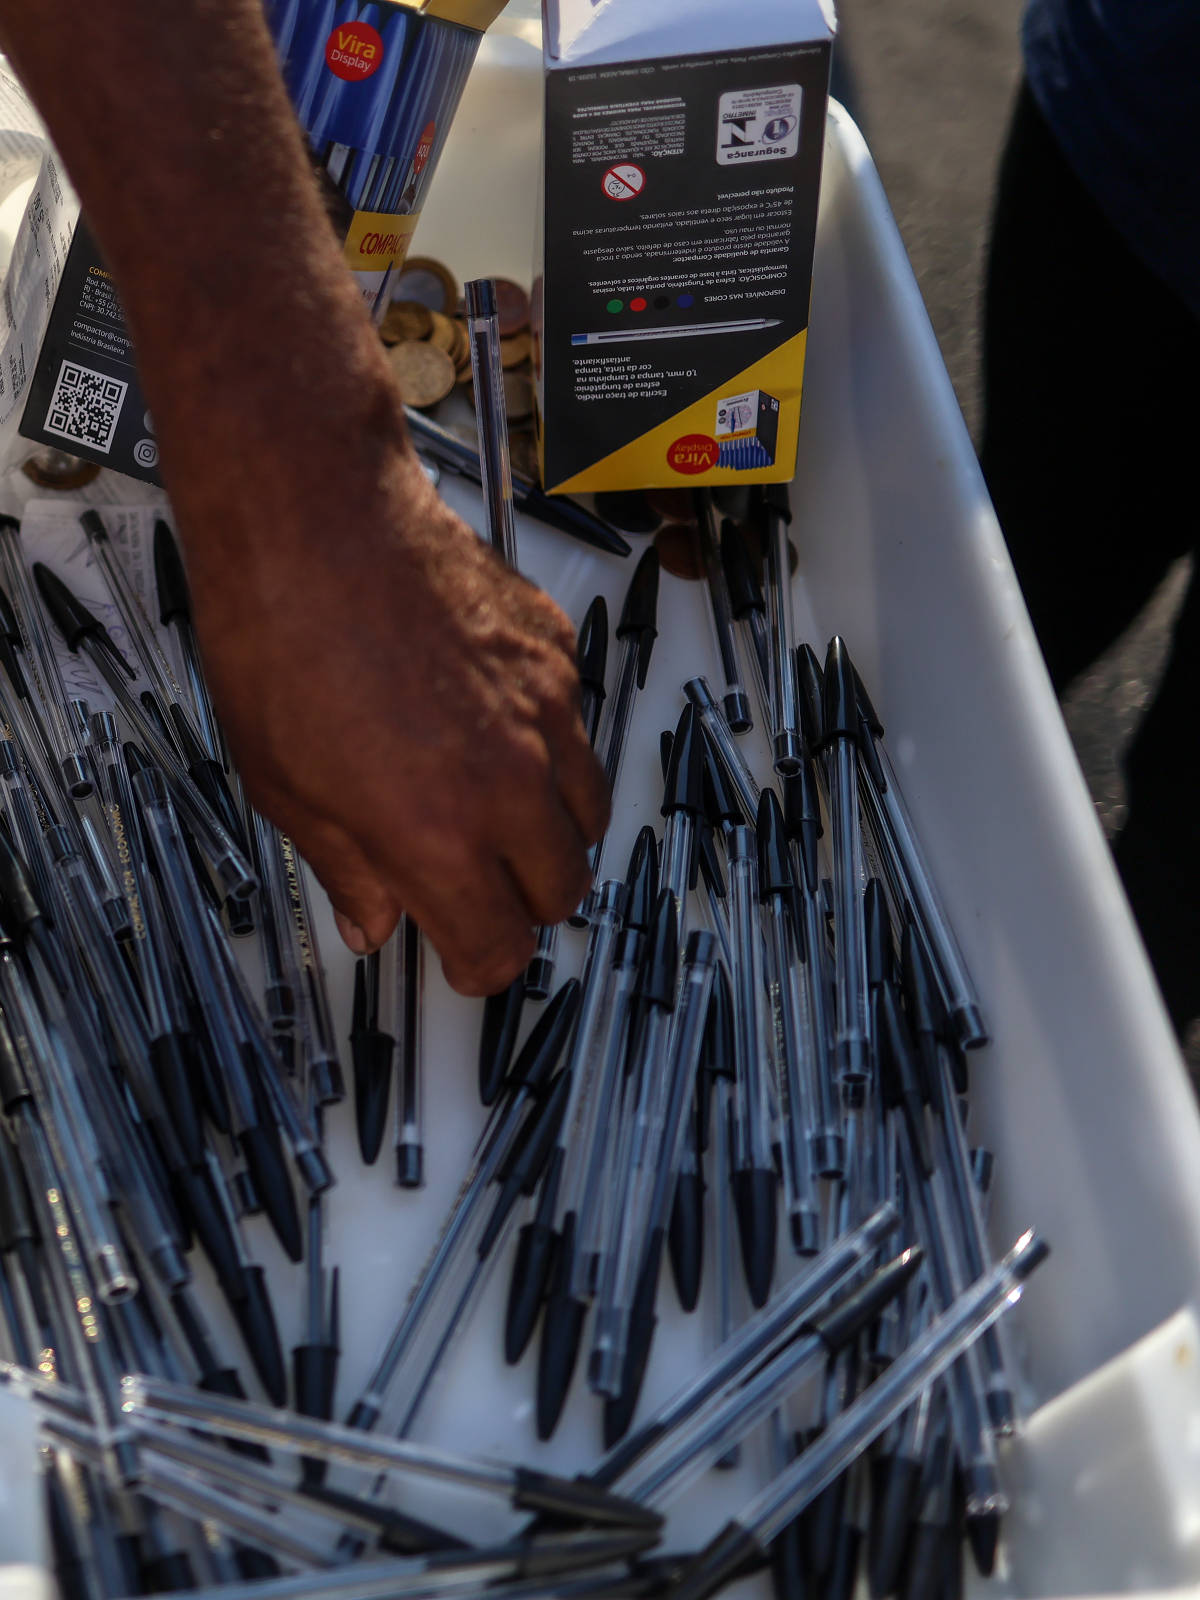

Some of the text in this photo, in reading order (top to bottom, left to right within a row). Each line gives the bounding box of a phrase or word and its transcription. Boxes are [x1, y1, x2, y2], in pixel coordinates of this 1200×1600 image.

[337, 31, 376, 59] Vira
[330, 50, 372, 73] Display
[722, 109, 756, 119] INMETRO
[726, 145, 787, 160] Segurança
[765, 185, 793, 195] Produto
[700, 206, 720, 215] direta
[722, 202, 757, 213] exposição
[639, 212, 665, 220] solares.
[733, 211, 752, 221] lugar
[766, 209, 791, 217] Estocar
[642, 221, 673, 230] evitando
[675, 217, 708, 227] ventilado,
[766, 222, 791, 231] normal
[571, 228, 593, 236] acima
[595, 223, 640, 234] temperaturas
[739, 232, 756, 241] pelo
[757, 229, 790, 239] garantida
[703, 235, 738, 245] fabricante
[753, 239, 783, 247] validade
[582, 245, 614, 255] desgaste
[634, 241, 661, 251] defeito,
[703, 242, 731, 252] produto
[759, 245, 789, 255] Garantia
[595, 254, 613, 262] troca
[621, 252, 642, 260] sendo
[671, 252, 712, 263] Compactor:
[713, 249, 748, 259] qualidade
[627, 274, 659, 284] orgânicos
[659, 273, 688, 281] corantes
[698, 270, 715, 278] base
[737, 271, 787, 282] COMPOSIÇÃO:
[645, 281, 665, 289] ponta
[715, 276, 735, 284] Esfera
[592, 286, 615, 294] resinas
[616, 284, 634, 292] latão,
[703, 293, 728, 302] CORES
[743, 288, 785, 299] DISPONÍVEL
[70, 329, 126, 355] Indústria Brasileira
[571, 355, 630, 367] antiasfixiante.
[574, 365, 601, 374] tampa
[603, 364, 625, 373] tinta,
[588, 372, 628, 383] tampinha
[636, 370, 664, 379] tampa
[622, 382, 633, 390] de
[634, 380, 660, 390] esfera
[575, 392, 603, 402] médio,
[605, 390, 626, 400] traço
[639, 389, 667, 398] Escrita
[673, 441, 713, 453] Display
[673, 451, 711, 466] Vira
[111, 803, 130, 864] ECONOMIC
